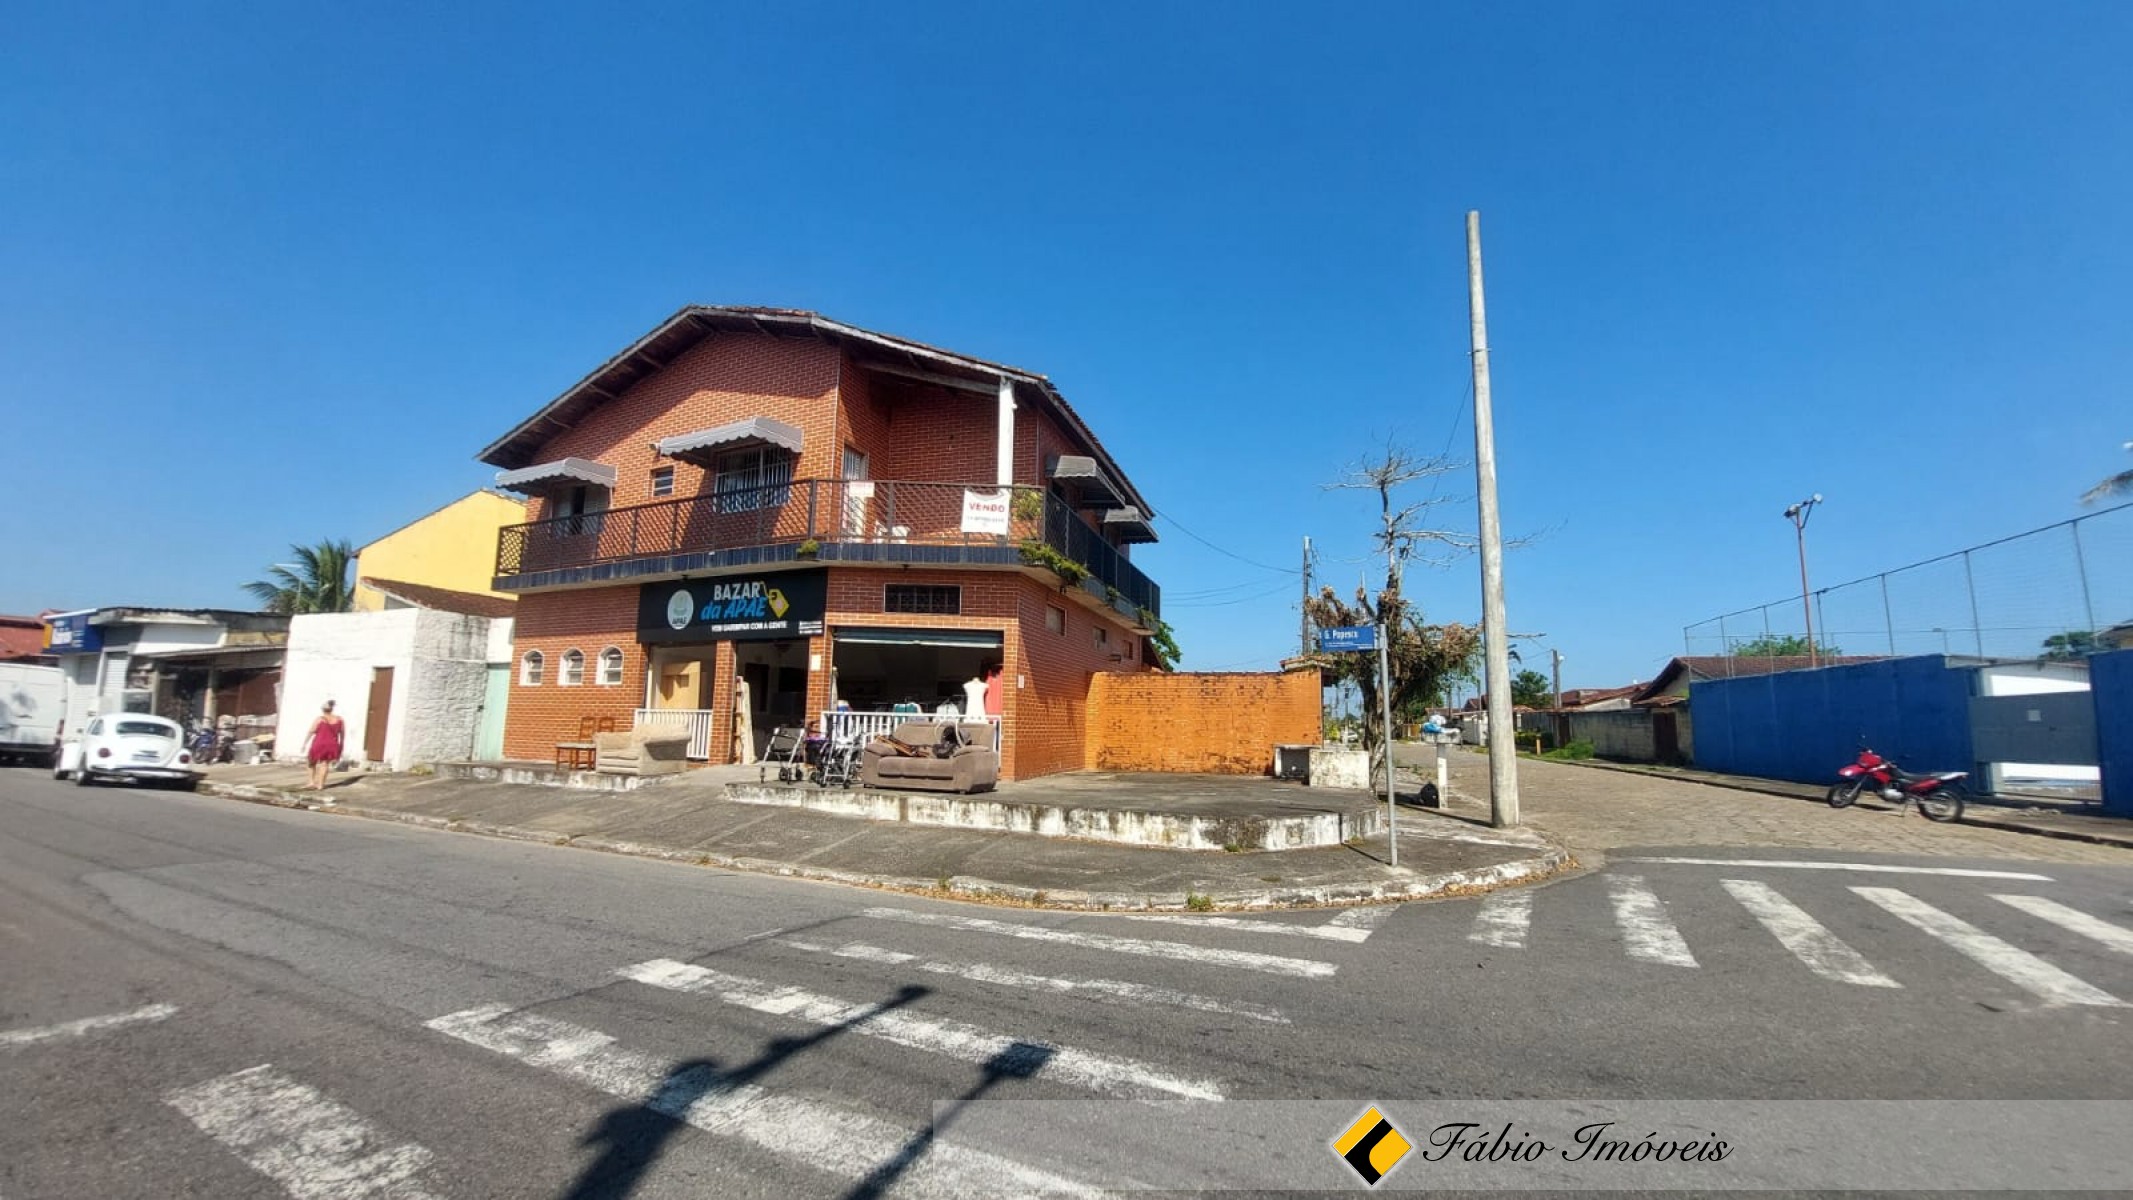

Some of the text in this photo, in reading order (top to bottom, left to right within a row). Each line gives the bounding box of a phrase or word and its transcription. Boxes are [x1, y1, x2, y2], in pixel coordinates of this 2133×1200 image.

[969, 502, 1005, 512] VENDO
[714, 582, 760, 600] BAZAR
[701, 597, 767, 620] da APAE
[750, 622, 763, 630] COM
